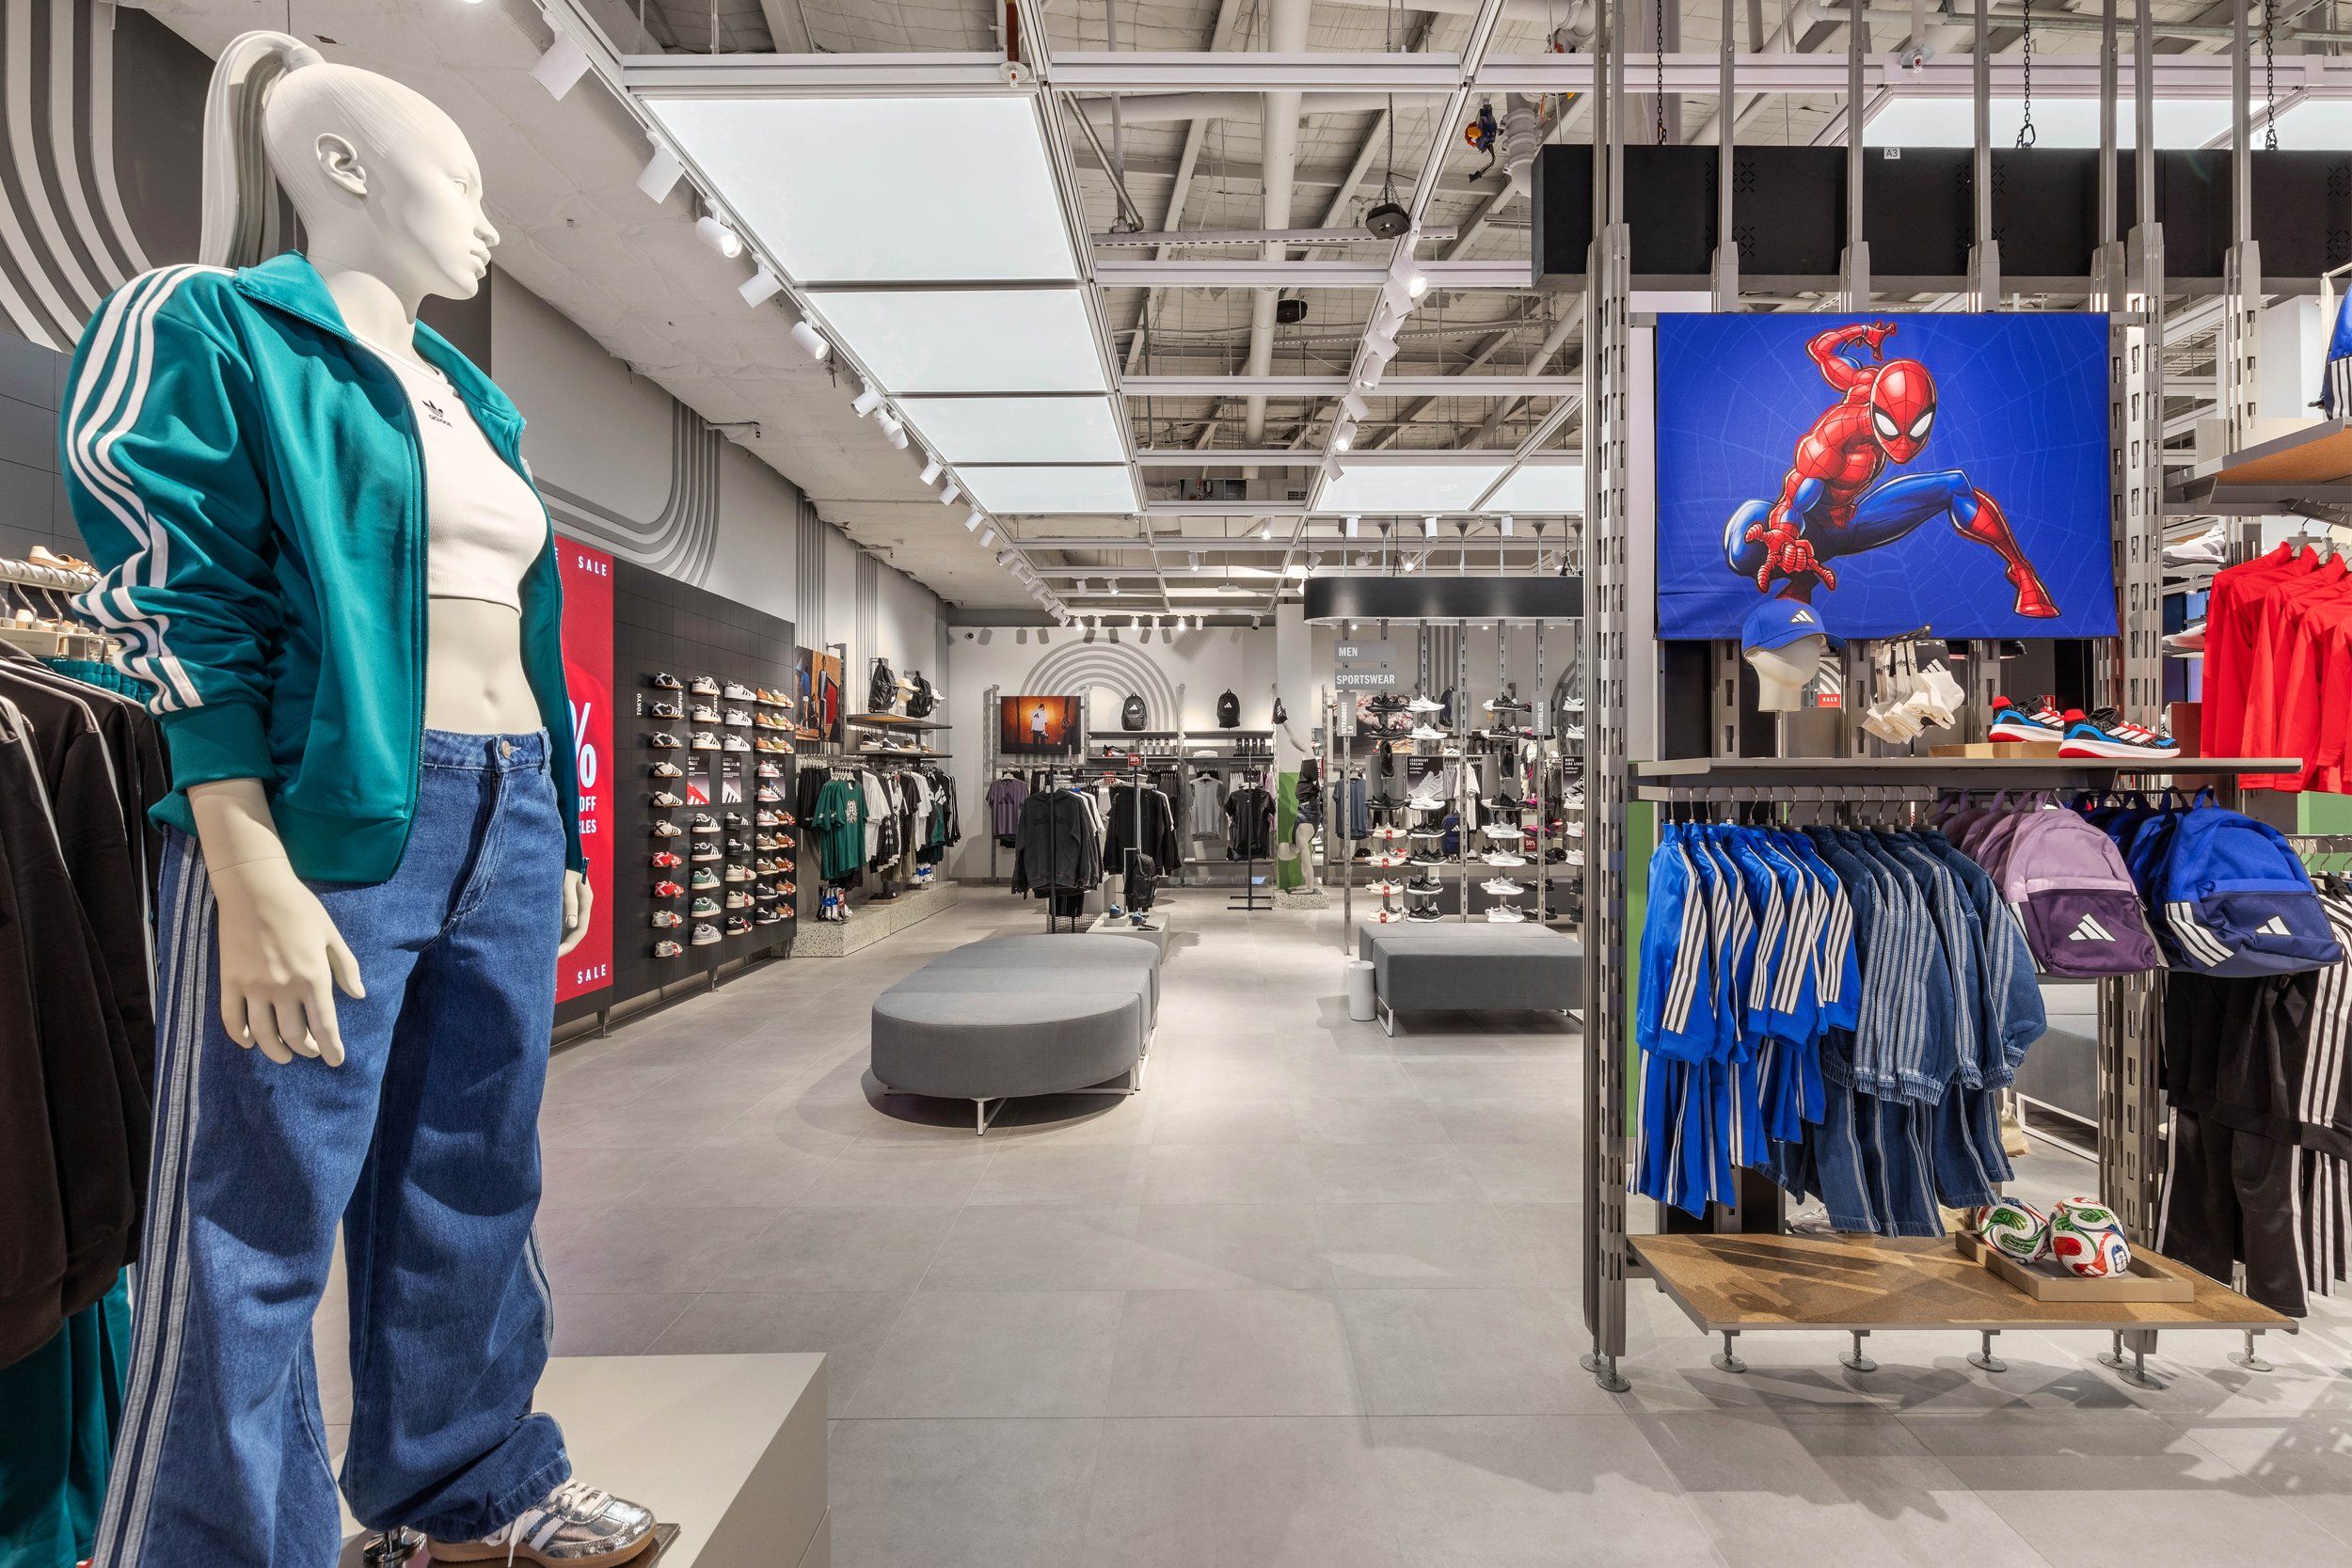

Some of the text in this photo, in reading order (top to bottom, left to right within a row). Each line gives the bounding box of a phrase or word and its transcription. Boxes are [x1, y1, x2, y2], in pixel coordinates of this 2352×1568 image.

[1885, 149, 1899, 158] A3
[578, 555, 608, 577] SALE
[1338, 646, 1359, 657] MEN
[1336, 674, 1395, 685] SPORTSWEAR
[579, 818, 597, 834] LES
[577, 963, 607, 985] SALE
